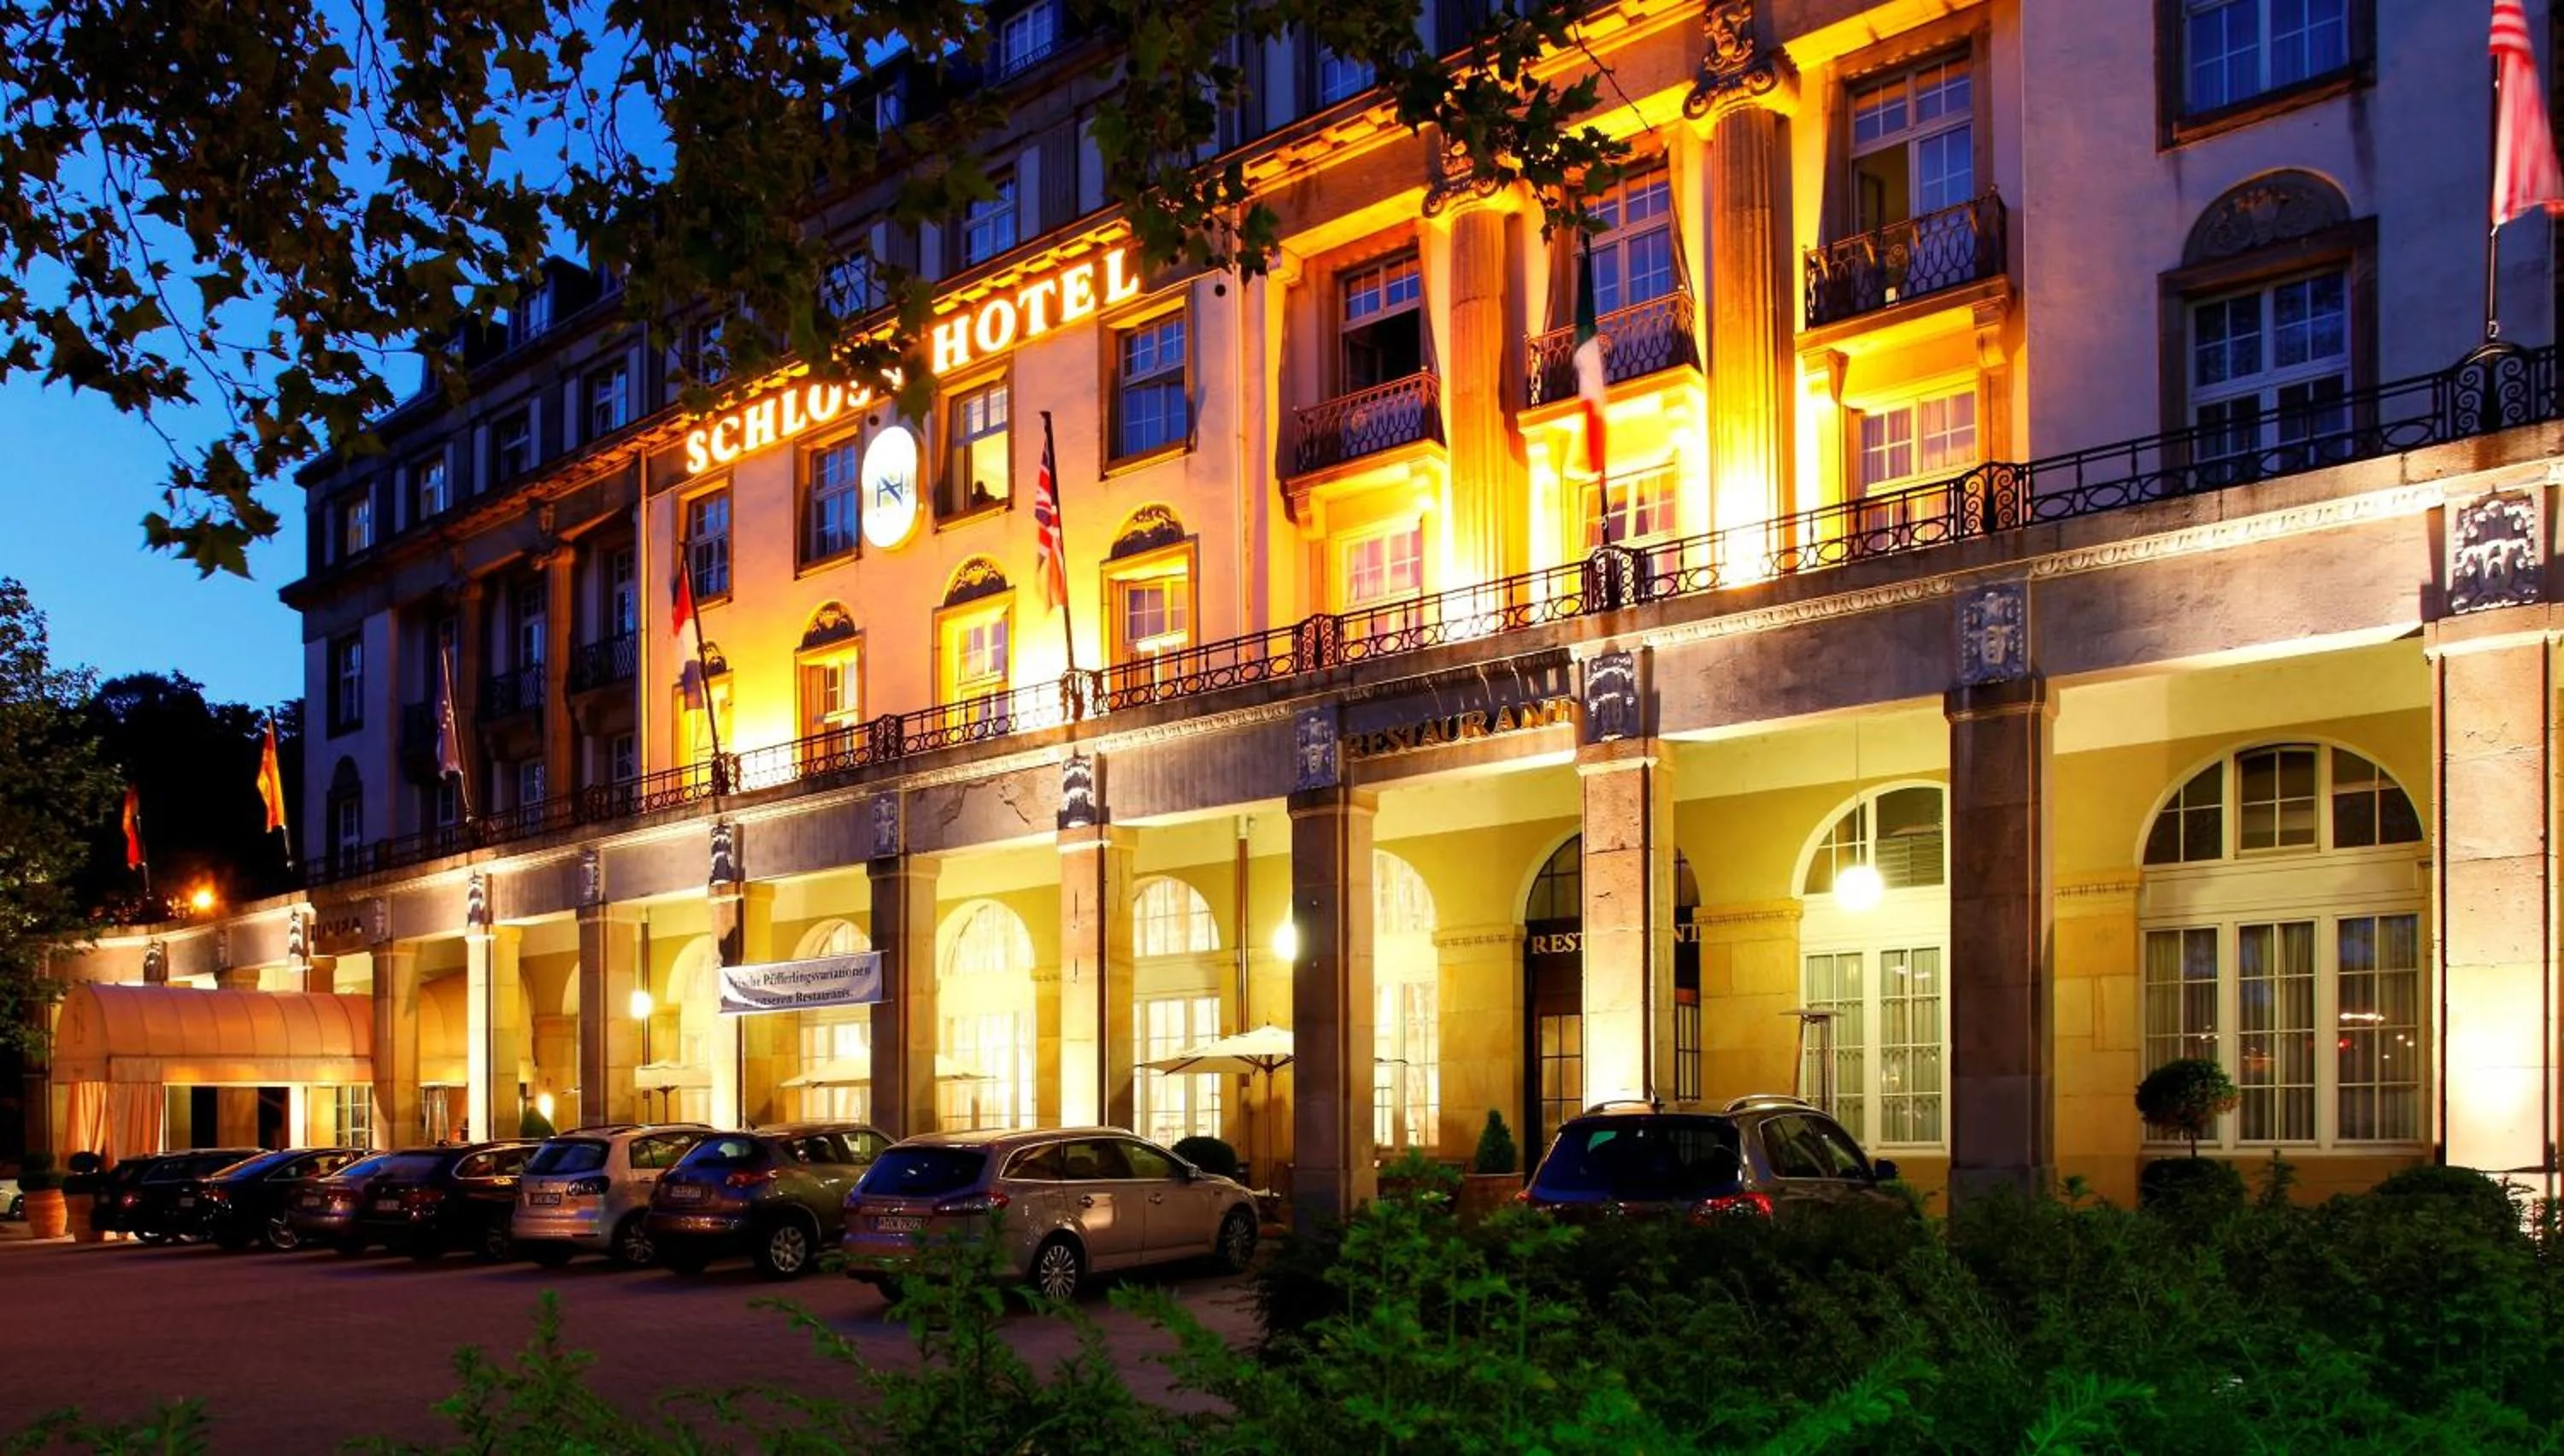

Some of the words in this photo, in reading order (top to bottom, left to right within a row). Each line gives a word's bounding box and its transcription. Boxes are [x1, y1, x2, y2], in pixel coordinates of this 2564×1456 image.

[685, 366, 904, 475] SCHLOS
[932, 247, 1140, 376] HOTEL
[1340, 696, 1576, 760] RESTAURANT
